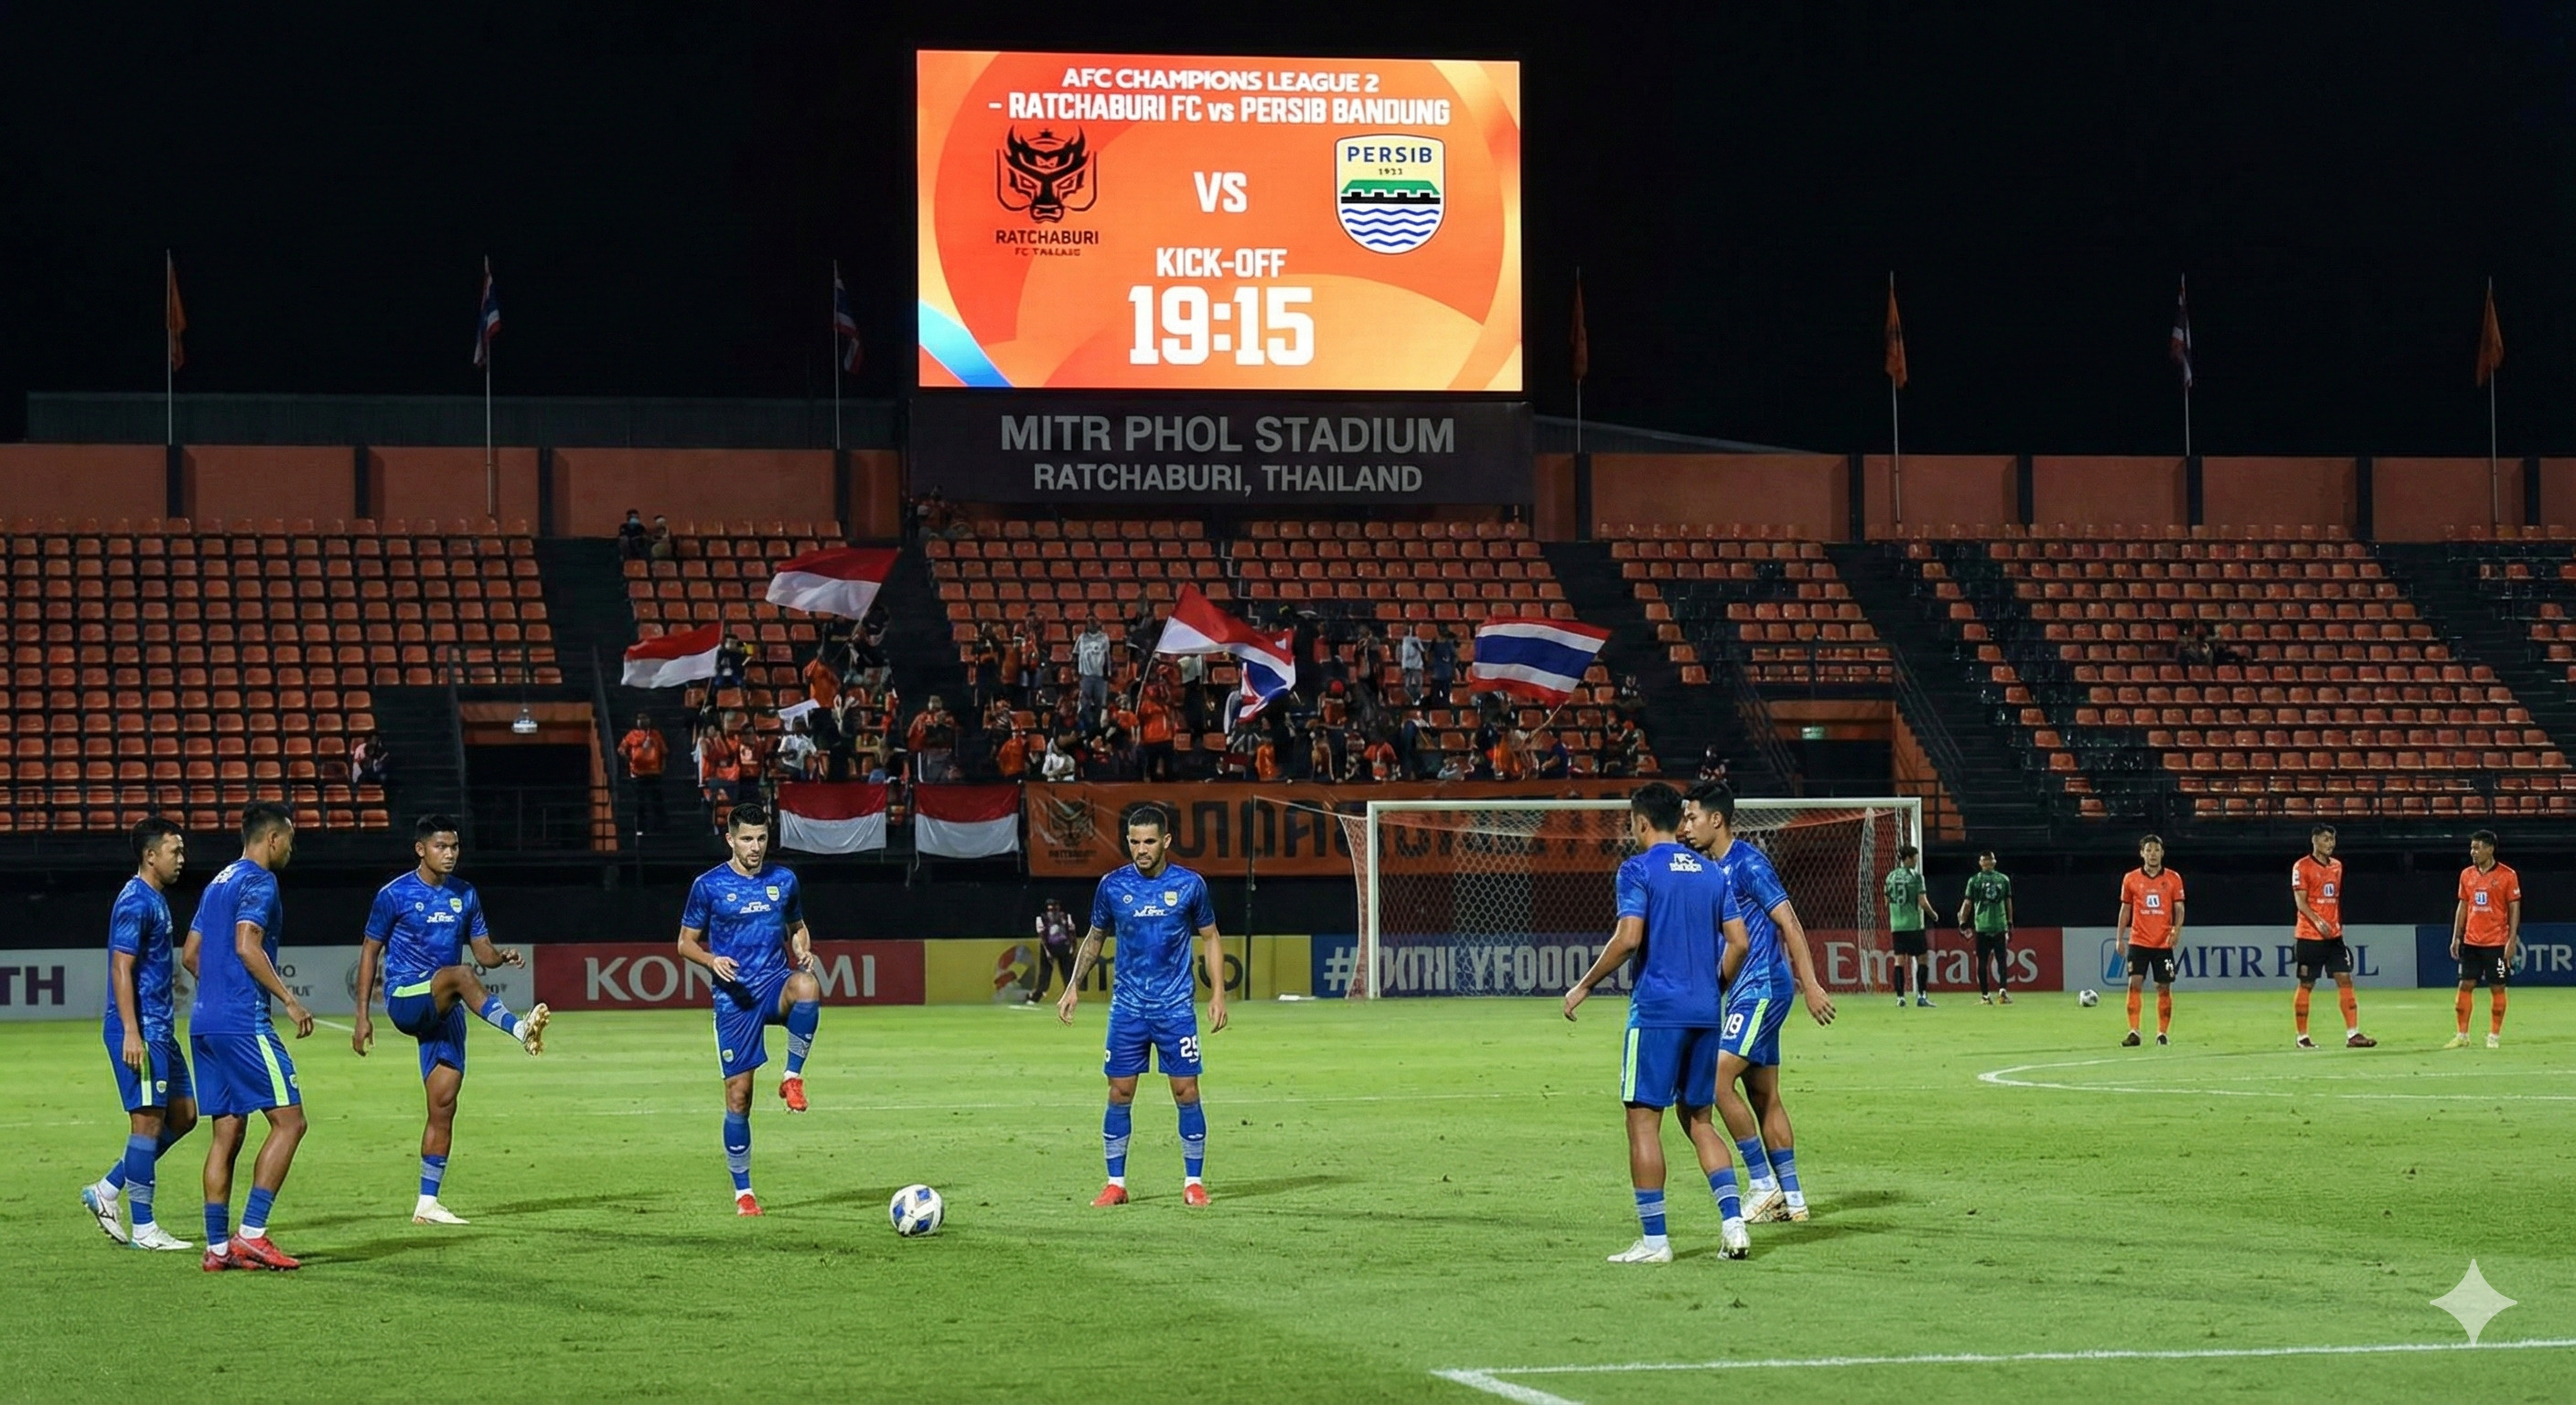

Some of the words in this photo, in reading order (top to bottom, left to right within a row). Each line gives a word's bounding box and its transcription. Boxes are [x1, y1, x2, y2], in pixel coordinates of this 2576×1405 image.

[1061, 68, 1112, 88] AFC
[1115, 70, 1262, 91] CHAMPIONS
[1267, 71, 1360, 92] LEAGUE
[1364, 74, 1379, 92] 2
[1008, 92, 1166, 121] RATCHABURI
[1172, 95, 1202, 122] FC
[1207, 102, 1235, 123] vs
[1240, 96, 1326, 123] PERSIB
[1332, 98, 1450, 125] BANDUNG
[1347, 146, 1433, 163] PERSIB
[1193, 171, 1248, 213] VS
[995, 230, 1099, 245] RATCHABURI
[1155, 247, 1288, 278] KICK-OFF
[1128, 285, 1315, 366] 19:15
[1001, 414, 1111, 451] MITR
[1125, 415, 1243, 452] PHOL
[1254, 417, 1454, 454] STADIUM
[1034, 463, 1252, 498] RATCHABURI,
[1261, 465, 1422, 492] THAILAND
[2174, 945, 2266, 978] MITR
[585, 955, 875, 1002] KONMI
